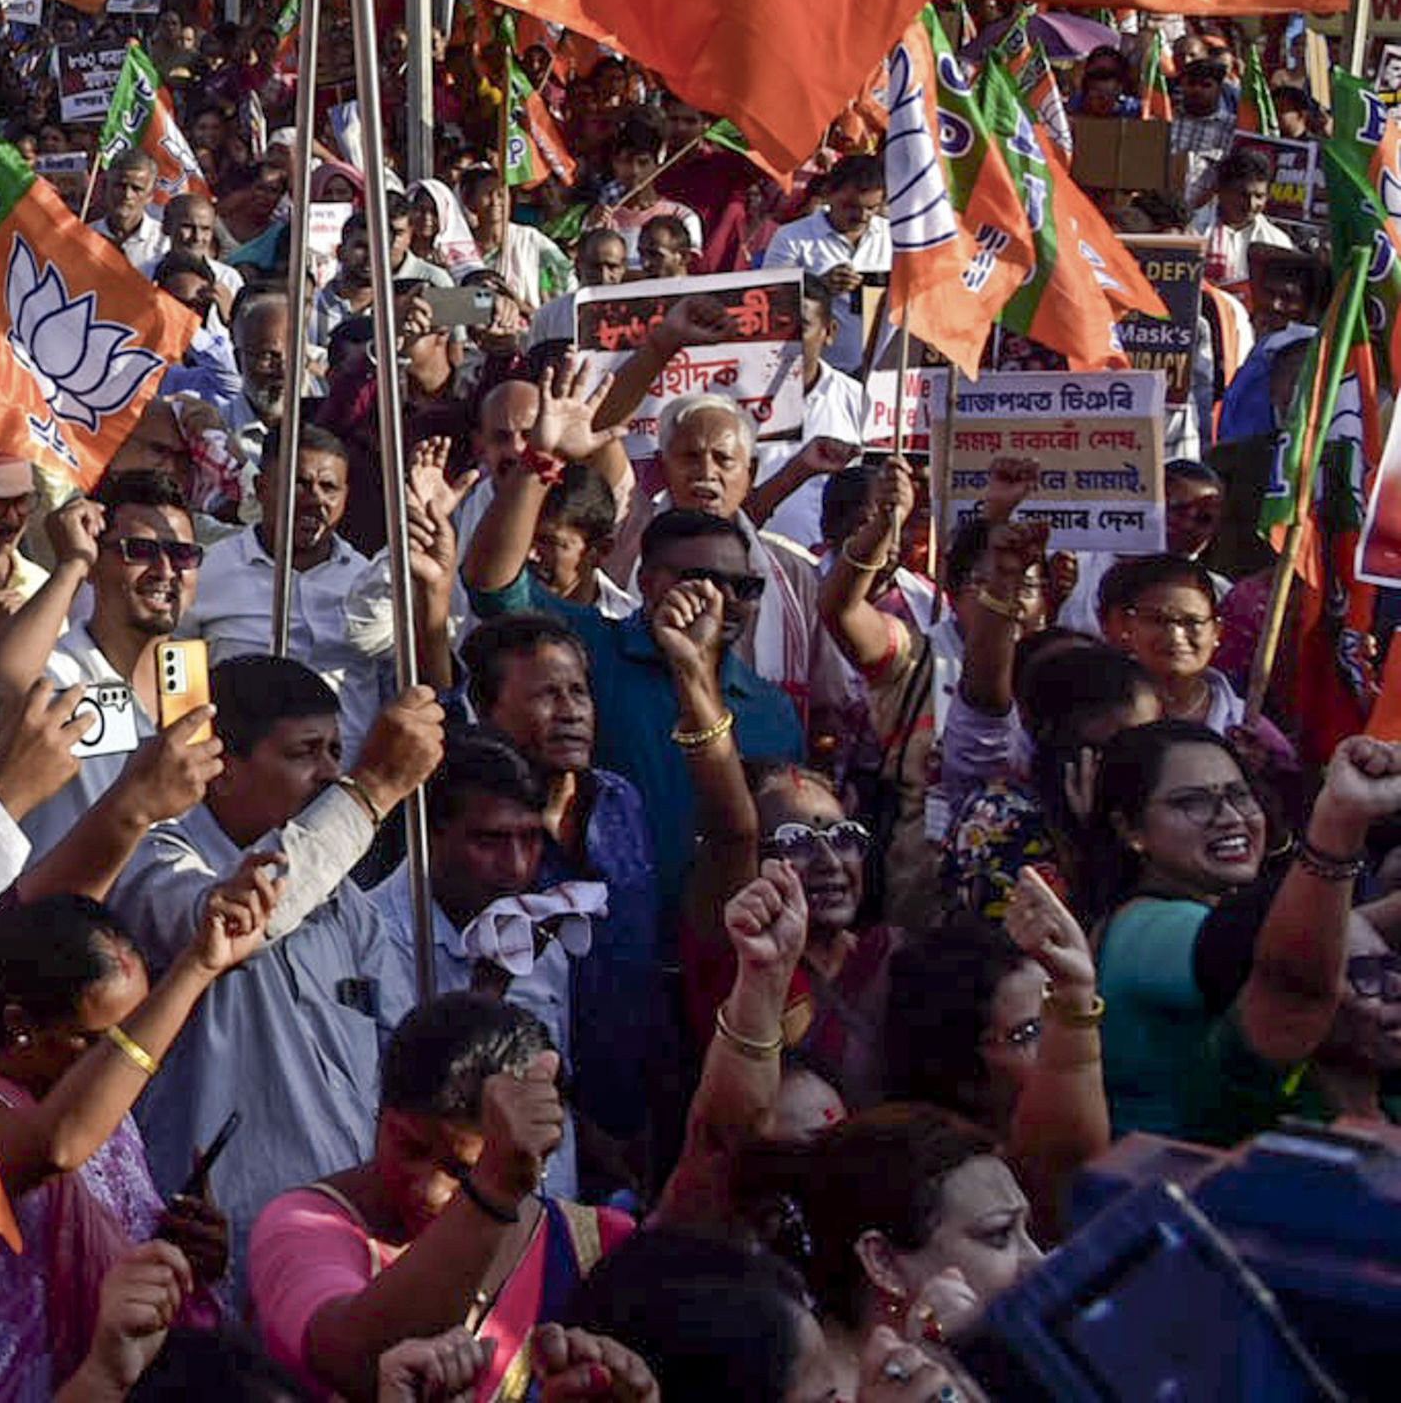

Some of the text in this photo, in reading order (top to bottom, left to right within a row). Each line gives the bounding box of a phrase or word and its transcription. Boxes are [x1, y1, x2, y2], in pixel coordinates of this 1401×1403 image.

[1147, 260, 1200, 282] DEFY
[904, 372, 932, 399] We
[874, 401, 918, 428] Pue
[1098, 508, 1146, 533] দেশ
